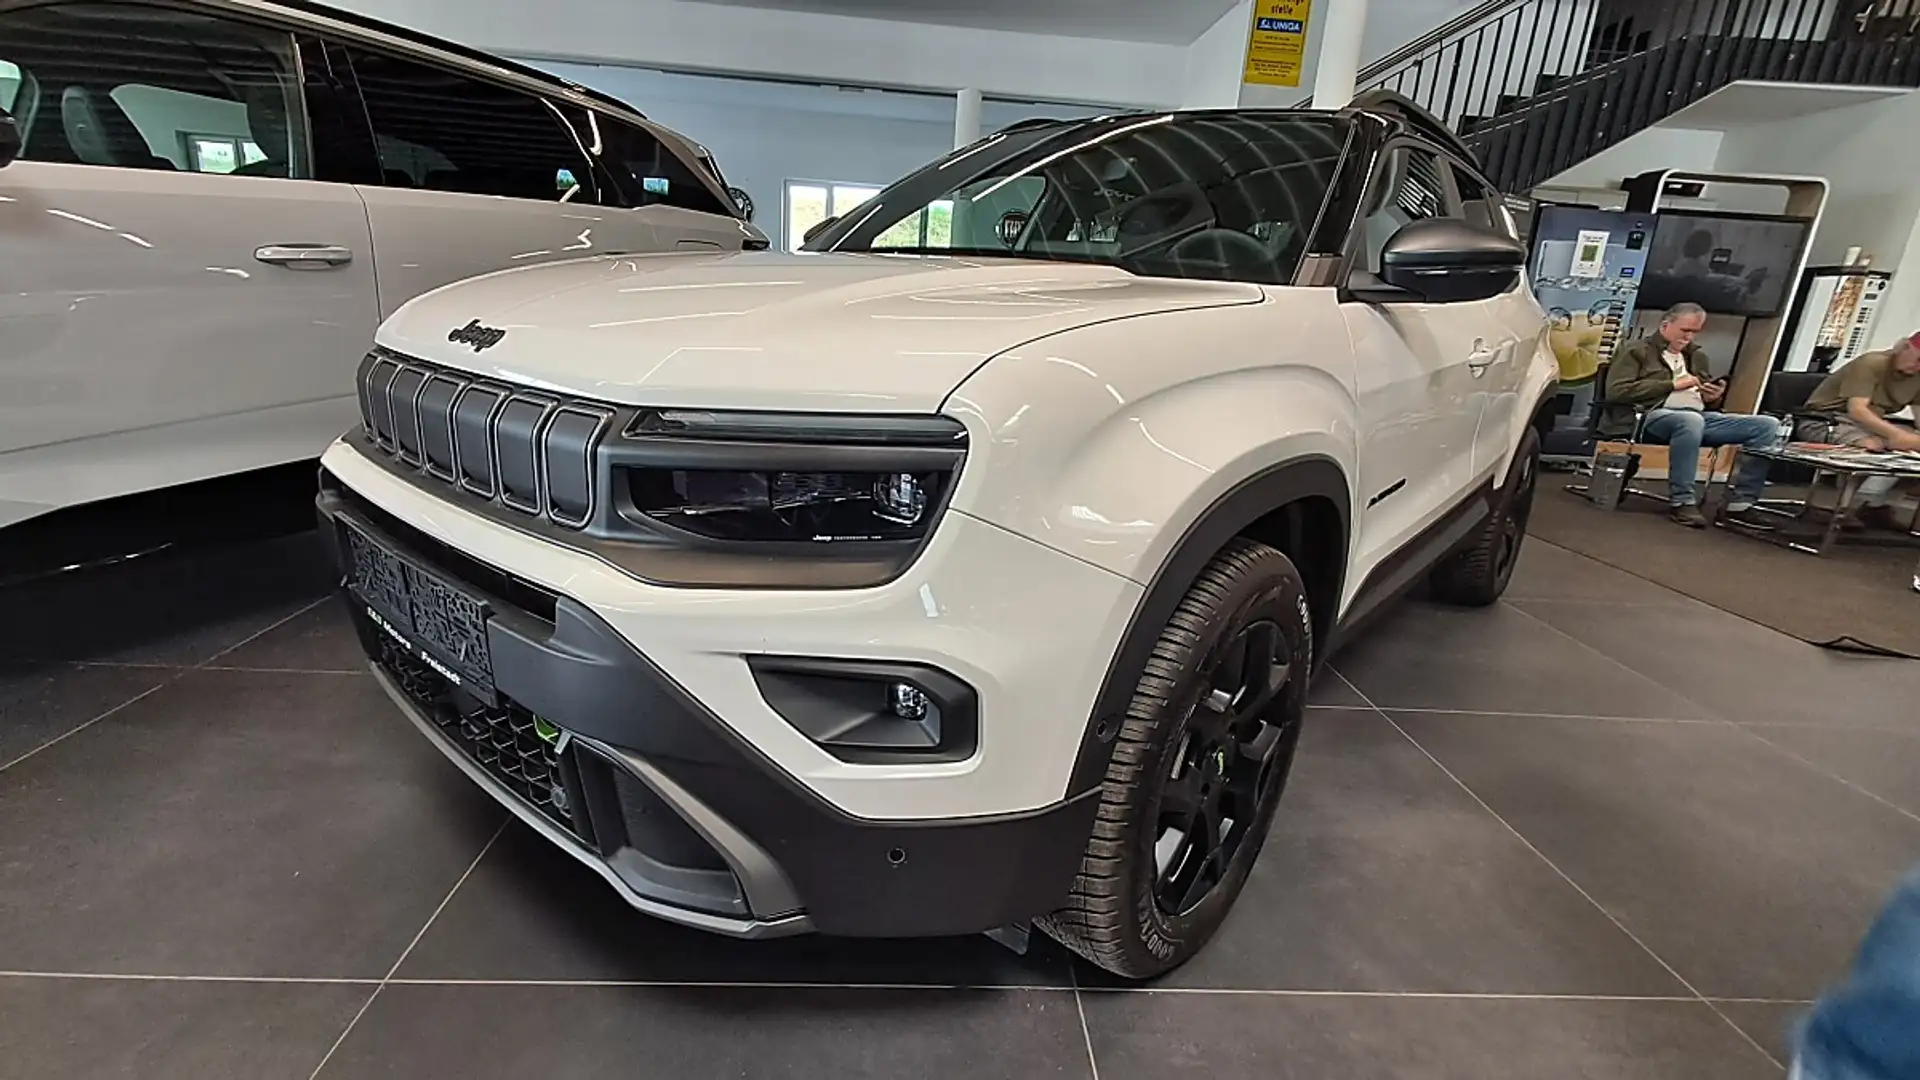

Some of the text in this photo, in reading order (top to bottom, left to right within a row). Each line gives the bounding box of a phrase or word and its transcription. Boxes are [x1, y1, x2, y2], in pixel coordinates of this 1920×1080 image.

[1272, 20, 1300, 32] UNIQA
[1004, 219, 1026, 238] FIA
[448, 318, 506, 353] Jeep
